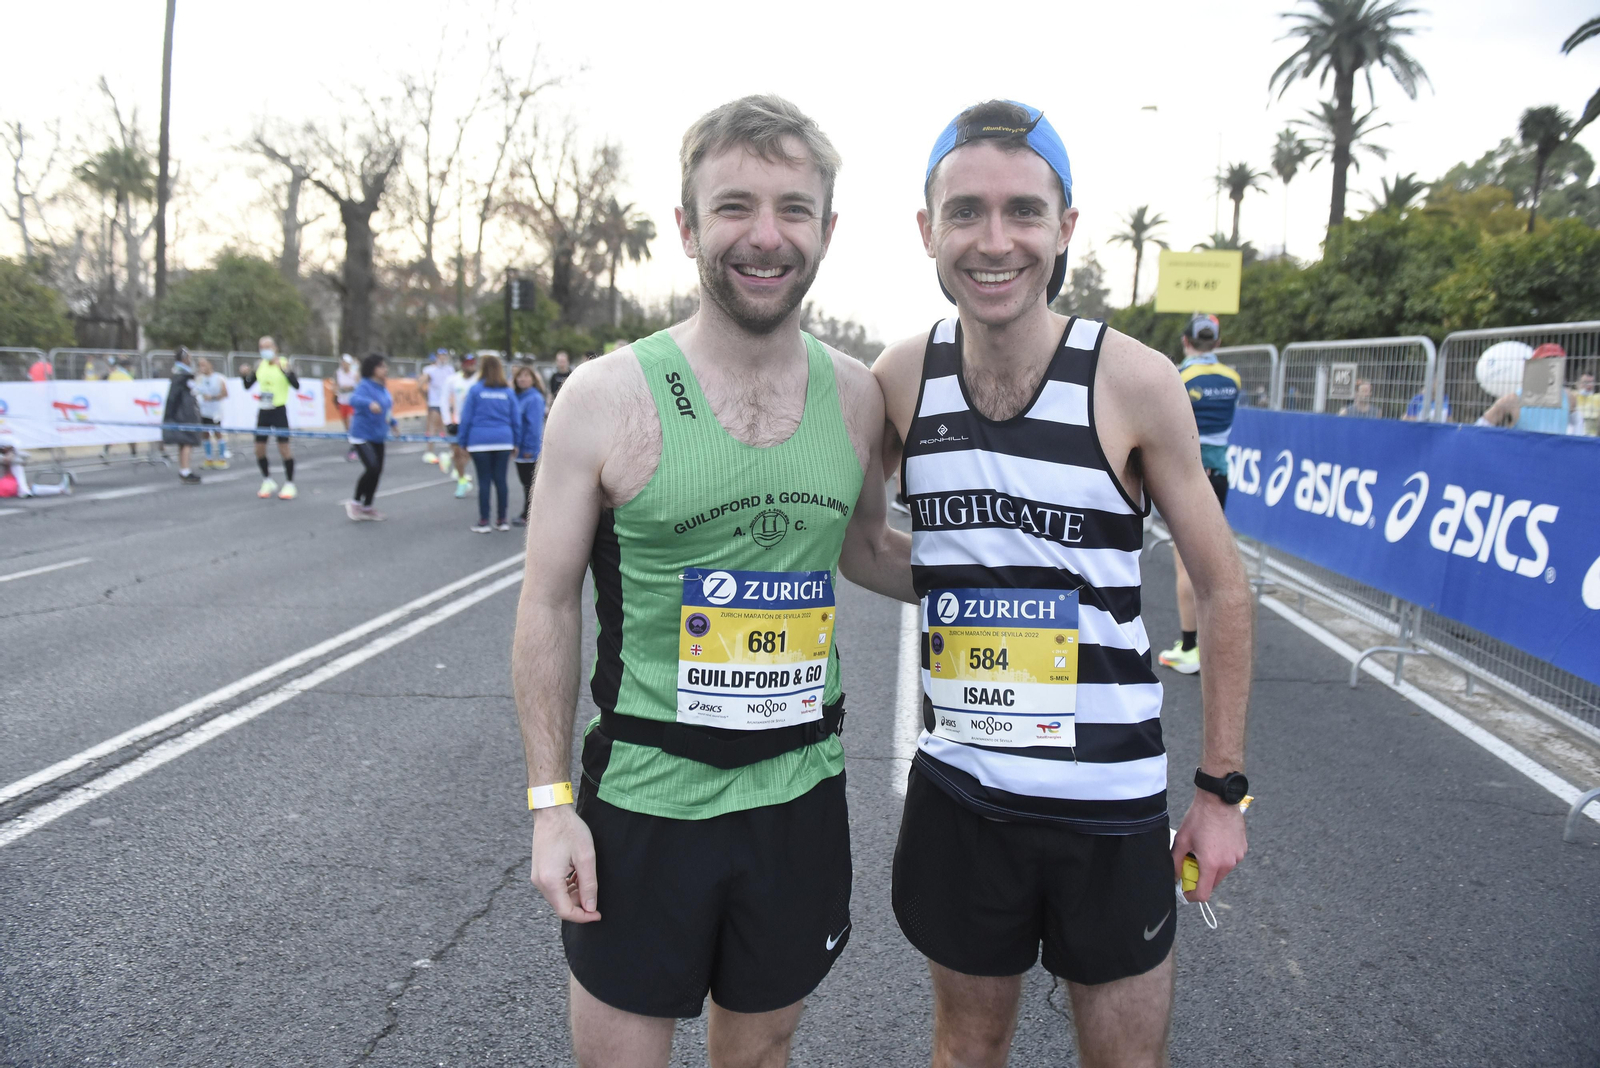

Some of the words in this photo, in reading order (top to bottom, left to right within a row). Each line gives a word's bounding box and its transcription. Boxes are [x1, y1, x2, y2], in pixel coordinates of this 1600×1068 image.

[666, 371, 696, 419] soar
[919, 435, 969, 445] RONHILL
[674, 495, 761, 534] GUILDFORD
[765, 493, 774, 505] &
[779, 492, 849, 517] GODALMING
[916, 494, 1084, 543] HIGHGATE
[1225, 444, 1262, 495] sics
[1294, 458, 1378, 527] asics
[1429, 483, 1560, 578] asics
[742, 580, 824, 601] ZURICH
[743, 612, 774, 620] MARATÓN
[963, 599, 1056, 620] ZURICH
[748, 630, 787, 653] 681
[969, 647, 1009, 670] 584
[687, 668, 790, 689] GUILDFORD
[793, 669, 803, 686] &
[805, 665, 823, 683] GO
[699, 702, 723, 713] asics
[964, 687, 1015, 707] ISAAC
